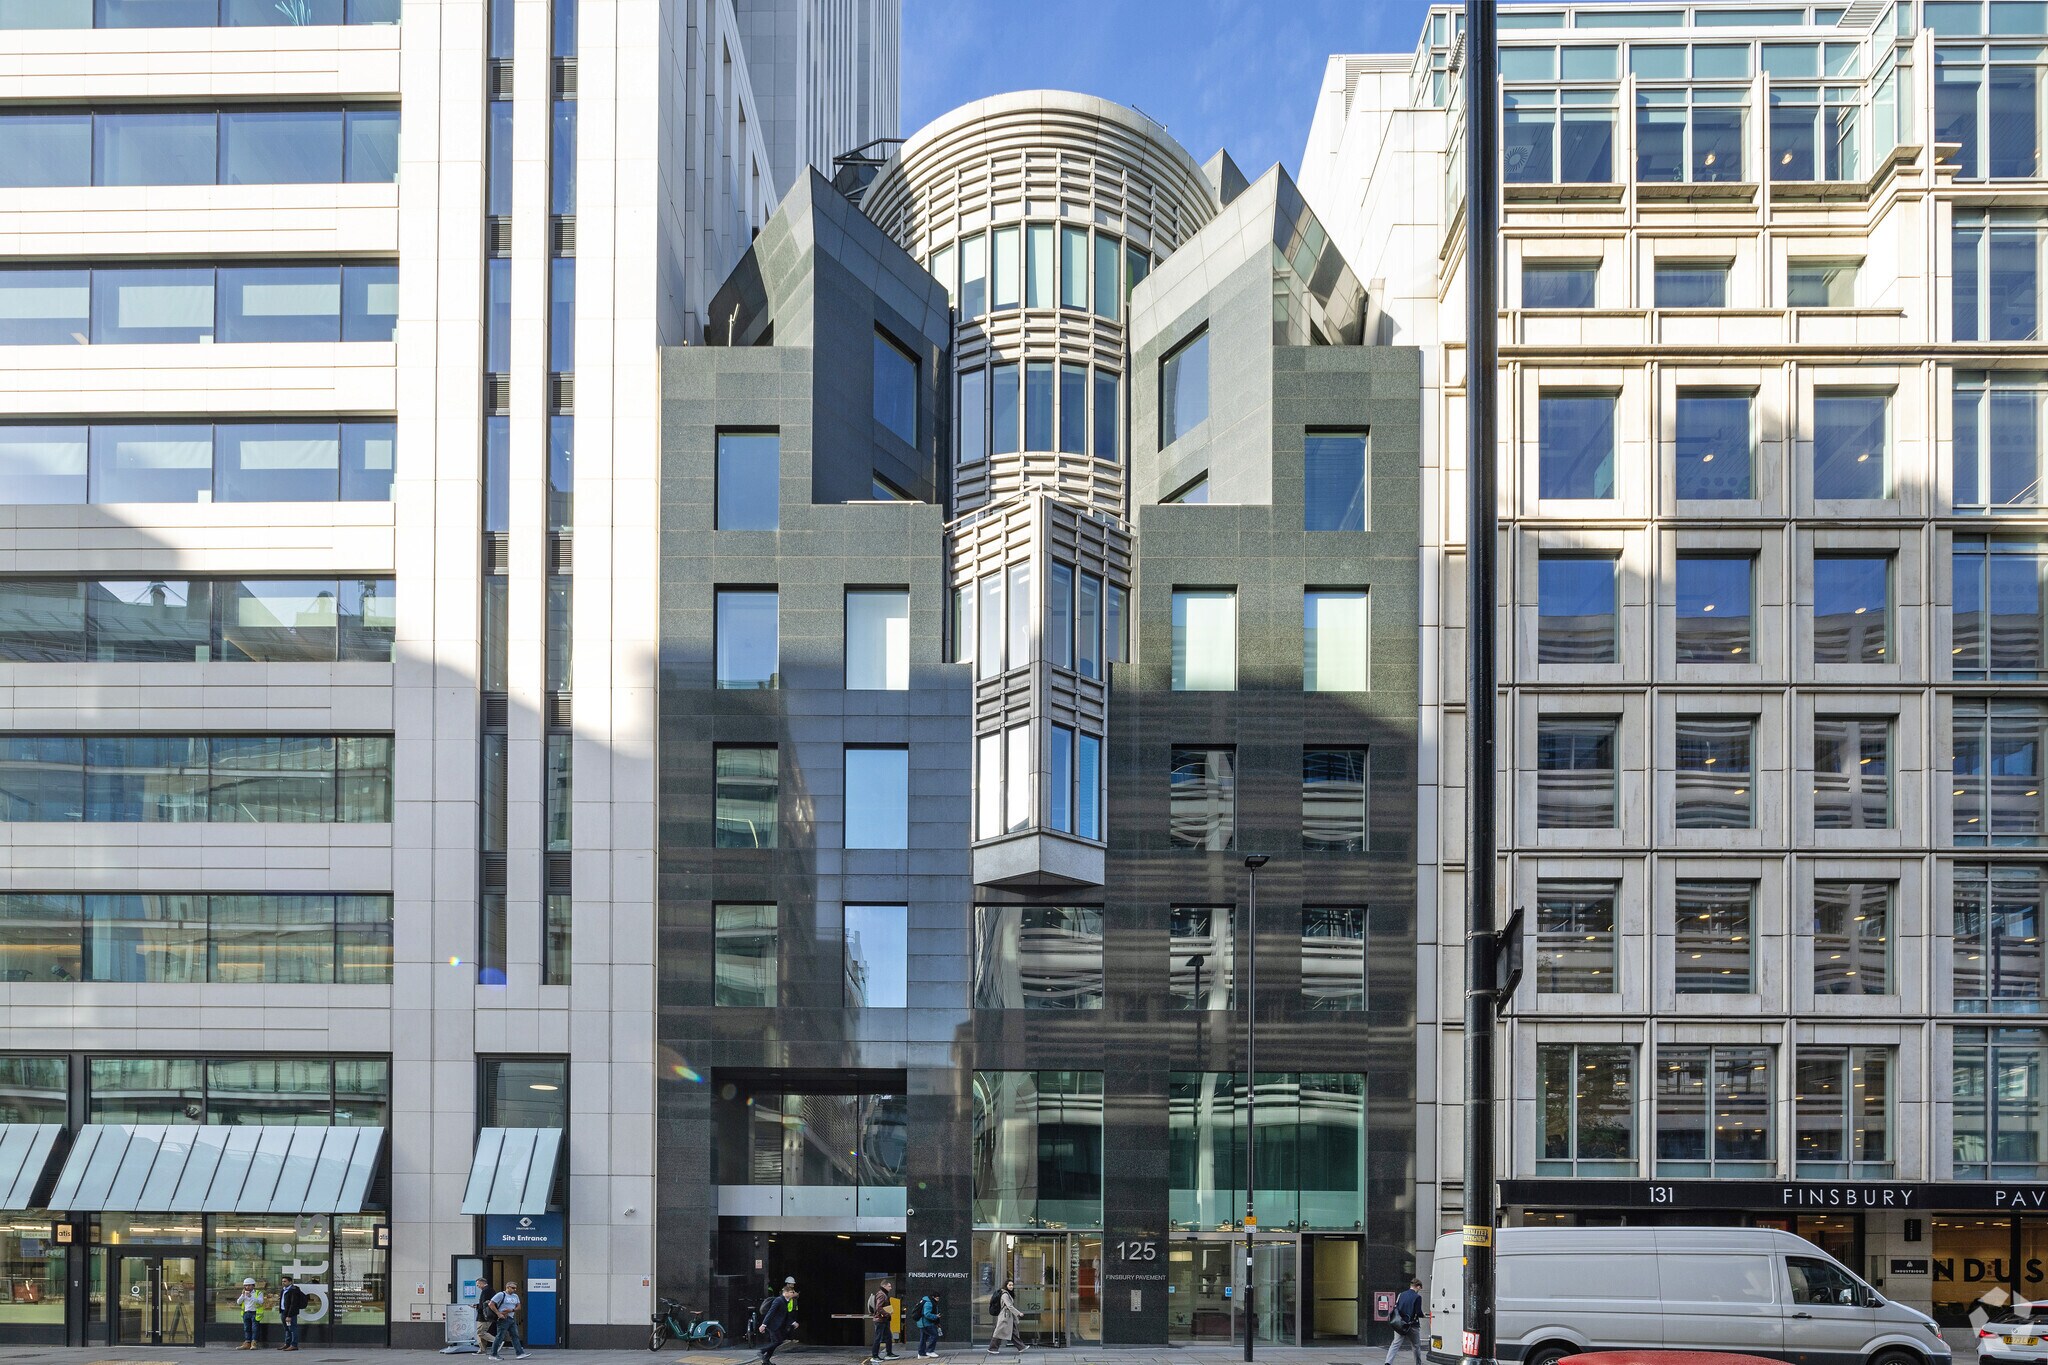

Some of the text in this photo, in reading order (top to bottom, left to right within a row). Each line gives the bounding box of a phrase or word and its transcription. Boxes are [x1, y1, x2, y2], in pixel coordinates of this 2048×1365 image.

[1649, 1186, 2046, 1206] 131 FINSBURY PAV
[517, 1234, 548, 1242] Entrance
[919, 1239, 958, 1258] 125
[1117, 1241, 1156, 1260] 125
[282, 1214, 329, 1322] atis
[1026, 1302, 1041, 1310] 125
